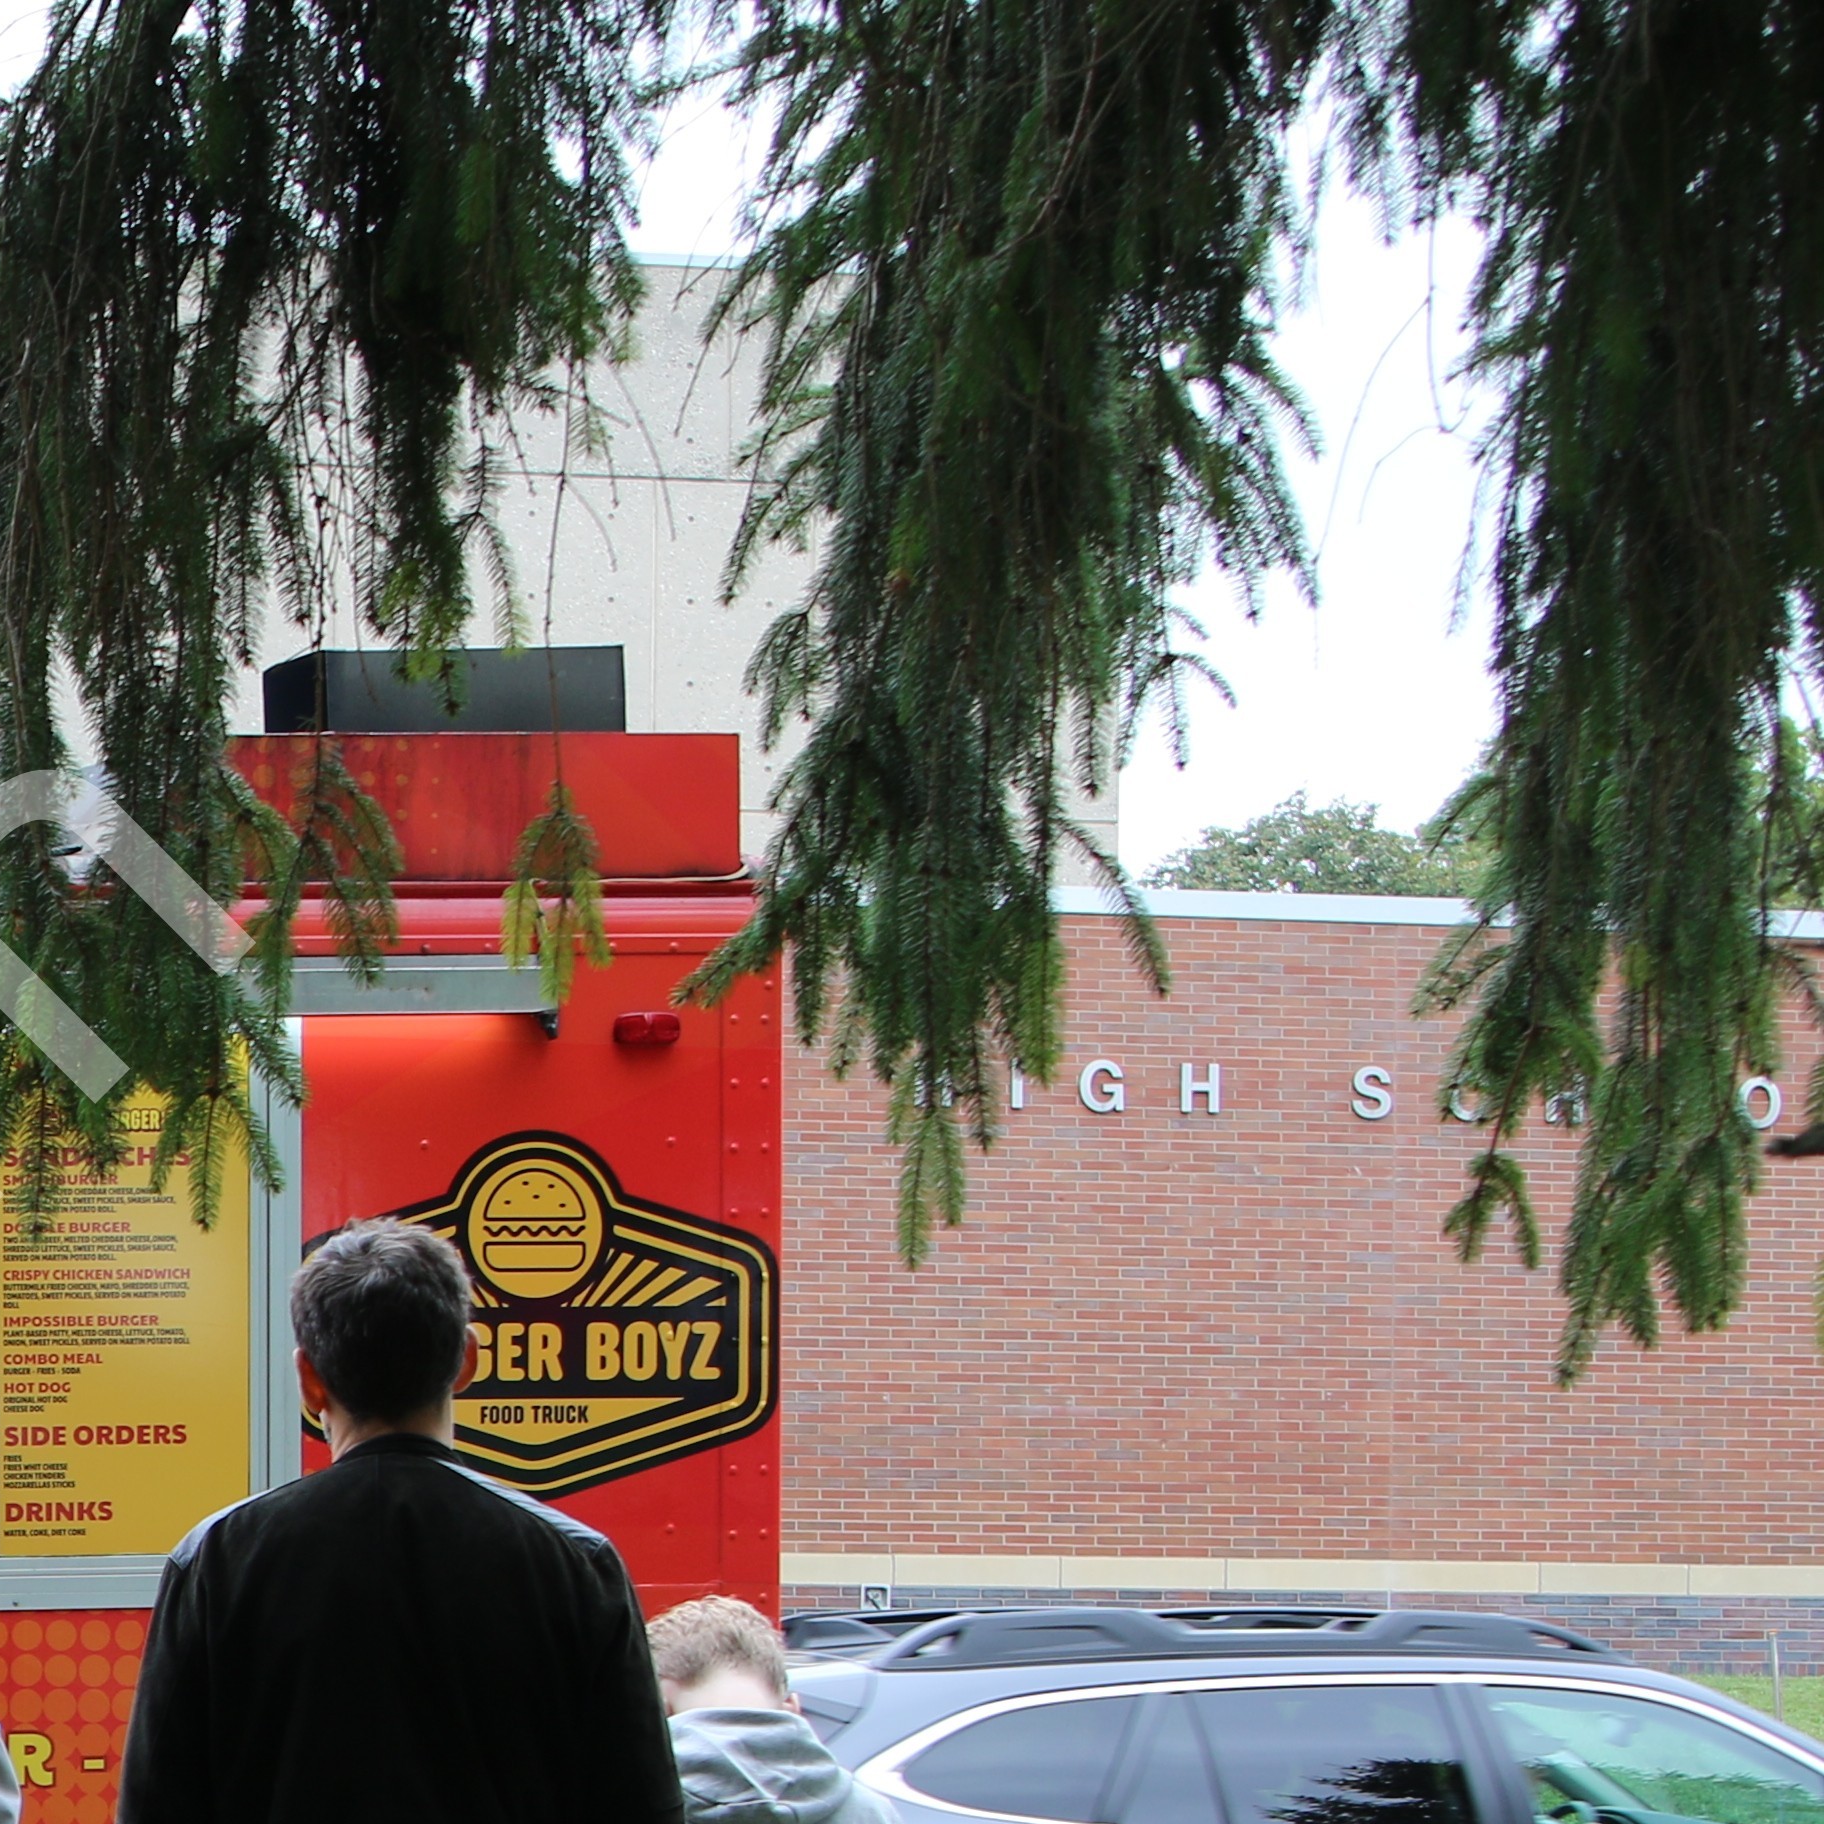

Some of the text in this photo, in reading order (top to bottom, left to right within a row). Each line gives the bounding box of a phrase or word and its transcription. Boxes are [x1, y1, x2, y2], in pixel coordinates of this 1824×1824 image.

[69, 1222, 132, 1234] BURGER
[3, 1269, 190, 1280] CRISPY CHICKEN SANDWICH
[4, 1315, 158, 1326] IMPOSSIBLE BURGER
[586, 1320, 722, 1382] BOYZ
[4, 1354, 103, 1364] COMBO MEAL
[4, 1382, 70, 1393] HOT DOG
[480, 1405, 589, 1425] FOOD TRUCK
[5, 1425, 187, 1446] SIDE ORDERS
[6, 1502, 112, 1522] DRINKS
